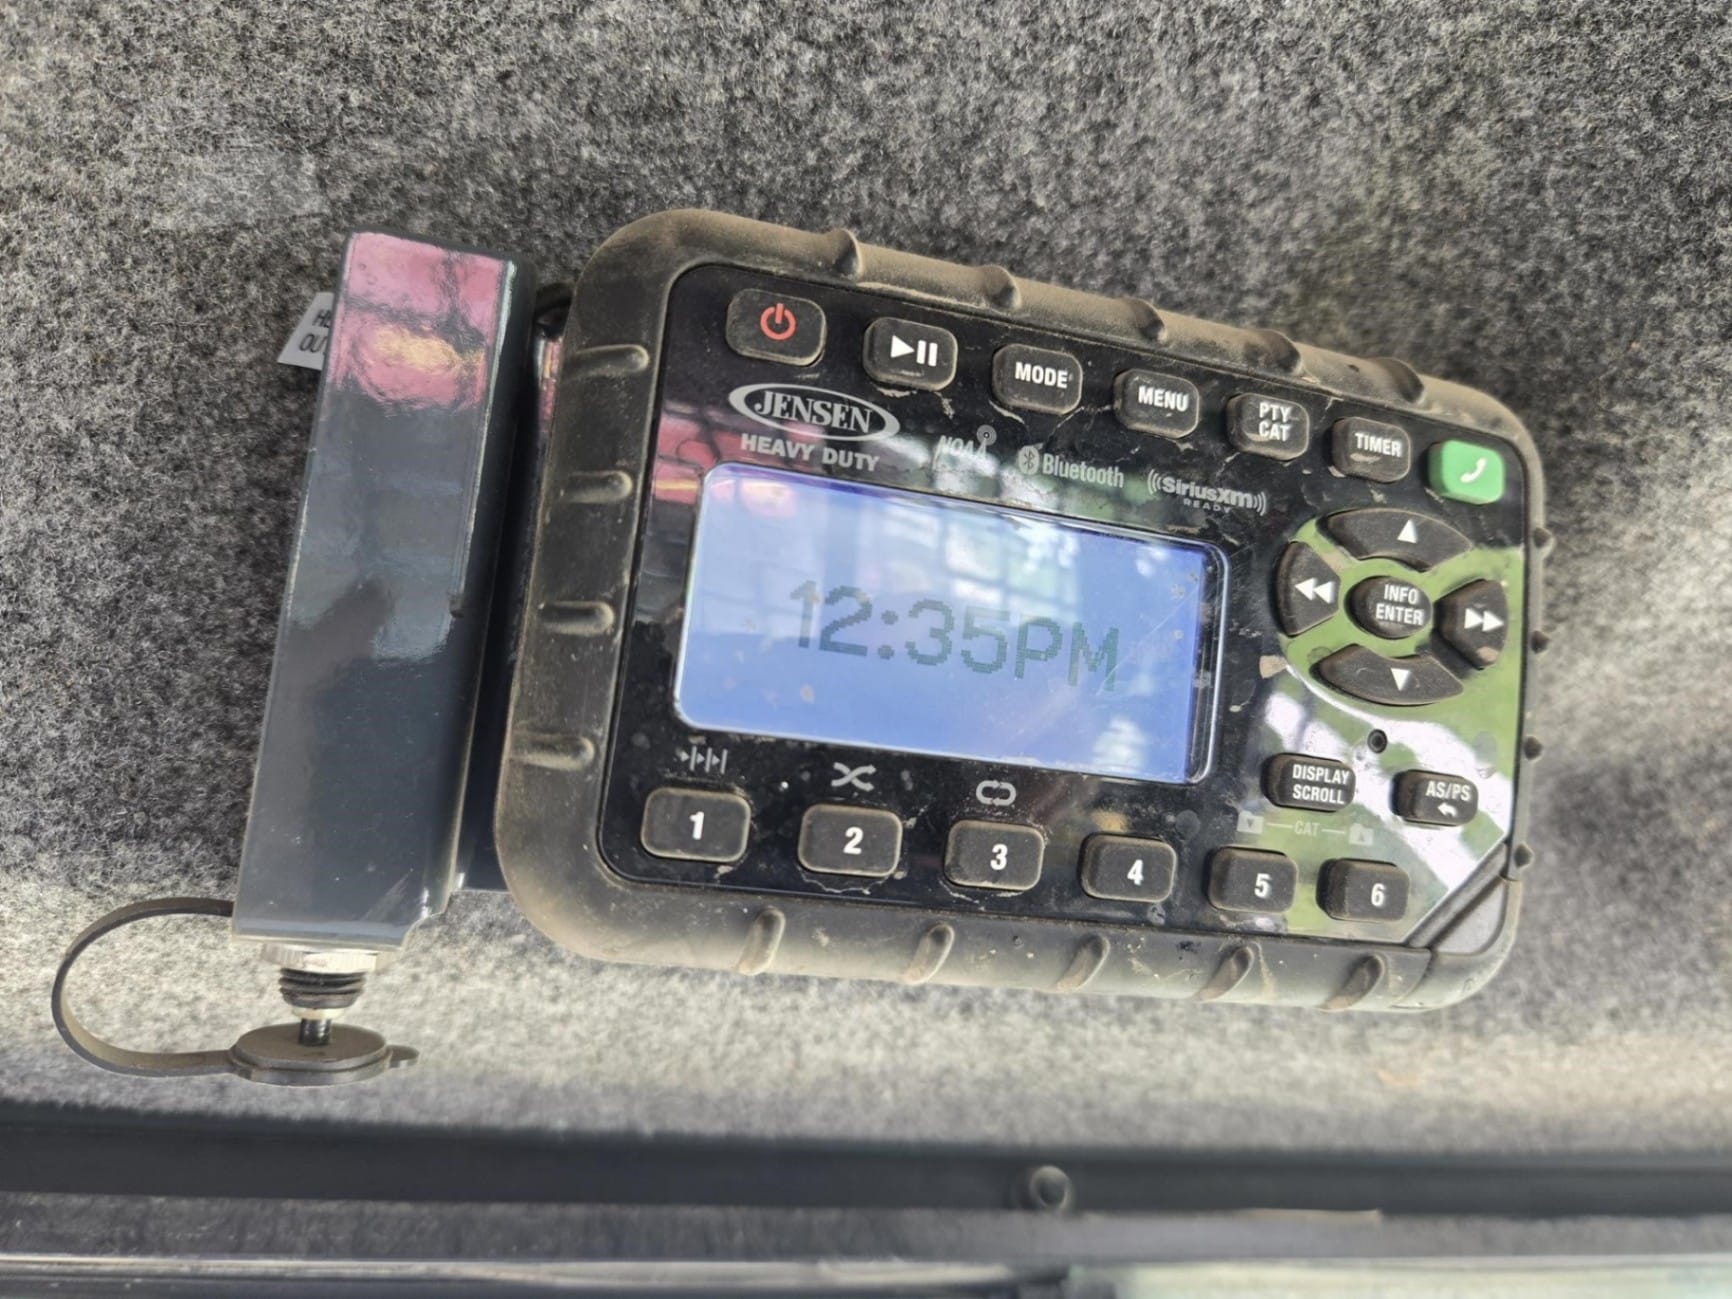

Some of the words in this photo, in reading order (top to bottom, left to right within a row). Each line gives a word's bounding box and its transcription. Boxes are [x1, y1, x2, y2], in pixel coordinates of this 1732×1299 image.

[1014, 361, 1068, 389] MODE
[1138, 386, 1189, 412] MENU
[753, 390, 872, 434] JENSEN
[1259, 401, 1293, 423] PTY
[1258, 421, 1291, 442] CAT
[1355, 432, 1402, 456] TIMER
[740, 433, 815, 462] HEAVY
[822, 443, 880, 472] DUTY
[1042, 453, 1124, 488] Bluetooth
[1183, 498, 1231, 513] READY
[1384, 583, 1418, 604] INFO
[1376, 602, 1424, 626] ENTER
[790, 580, 1119, 692] 12:35PM
[1292, 764, 1350, 785] DISPLAY
[1292, 784, 1345, 805] SCROLL
[1426, 780, 1471, 801] AS/PS
[689, 811, 704, 840] 1
[1295, 820, 1320, 837] CAT
[844, 827, 863, 855] 2
[990, 844, 1009, 871] 3
[1127, 859, 1144, 885] 4
[1254, 872, 1271, 898] 5
[1371, 883, 1386, 908] 6
